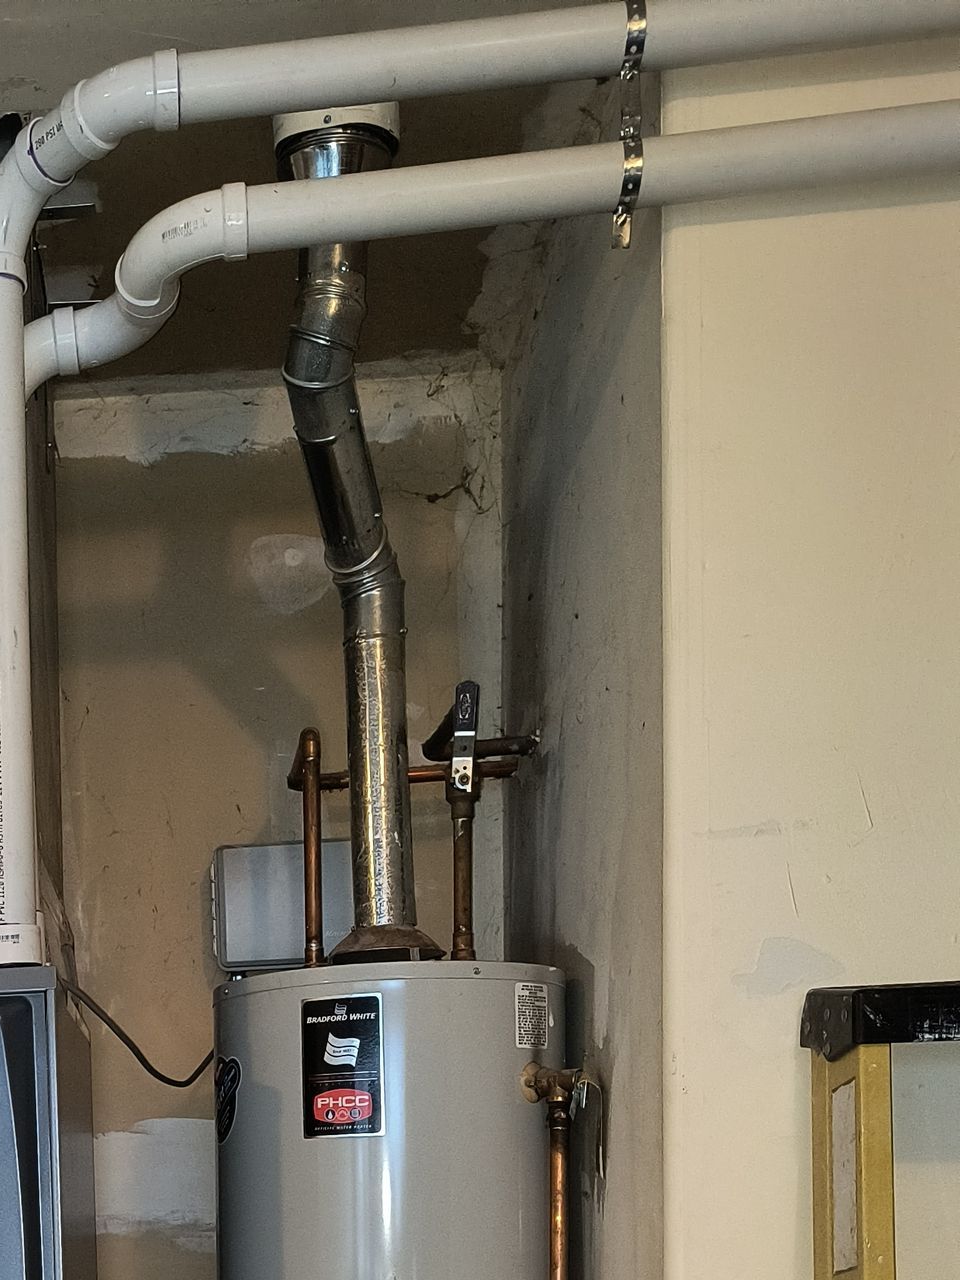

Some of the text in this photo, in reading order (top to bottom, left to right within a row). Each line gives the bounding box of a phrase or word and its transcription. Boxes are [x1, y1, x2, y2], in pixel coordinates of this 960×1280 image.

[46, 126, 56, 141] PSI
[306, 1012, 377, 1024] BRADFORD WHITE
[317, 1095, 370, 1109] PHCC
